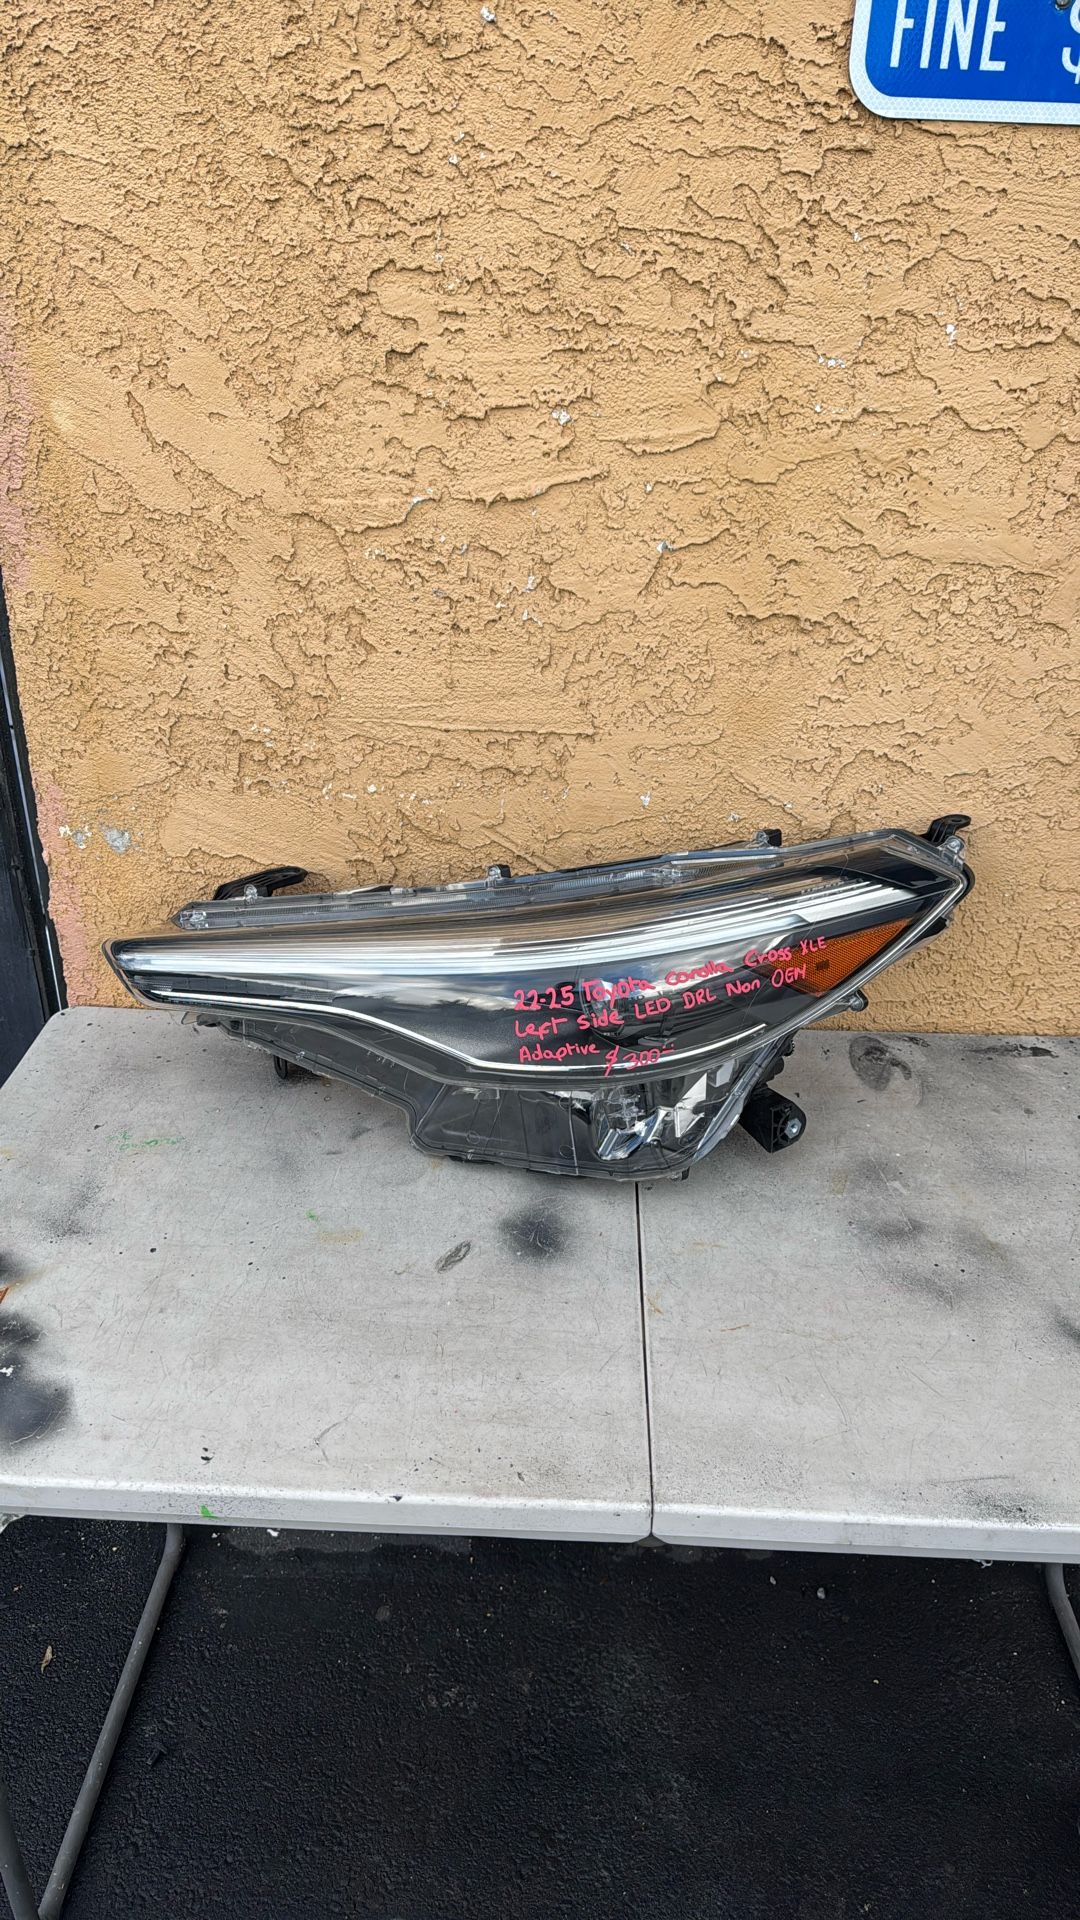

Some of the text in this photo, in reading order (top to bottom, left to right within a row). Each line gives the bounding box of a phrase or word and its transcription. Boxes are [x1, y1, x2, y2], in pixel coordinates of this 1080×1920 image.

[889, 0, 1007, 72] FINE
[513, 985, 575, 1011] 22-25
[582, 976, 656, 1009] Toyota
[743, 946, 793, 968] Cross
[800, 936, 828, 956] XLE
[634, 996, 671, 1020] LED
[683, 989, 717, 1010] DRL
[725, 978, 761, 997] Non
[519, 1043, 601, 1064] Adaptive
